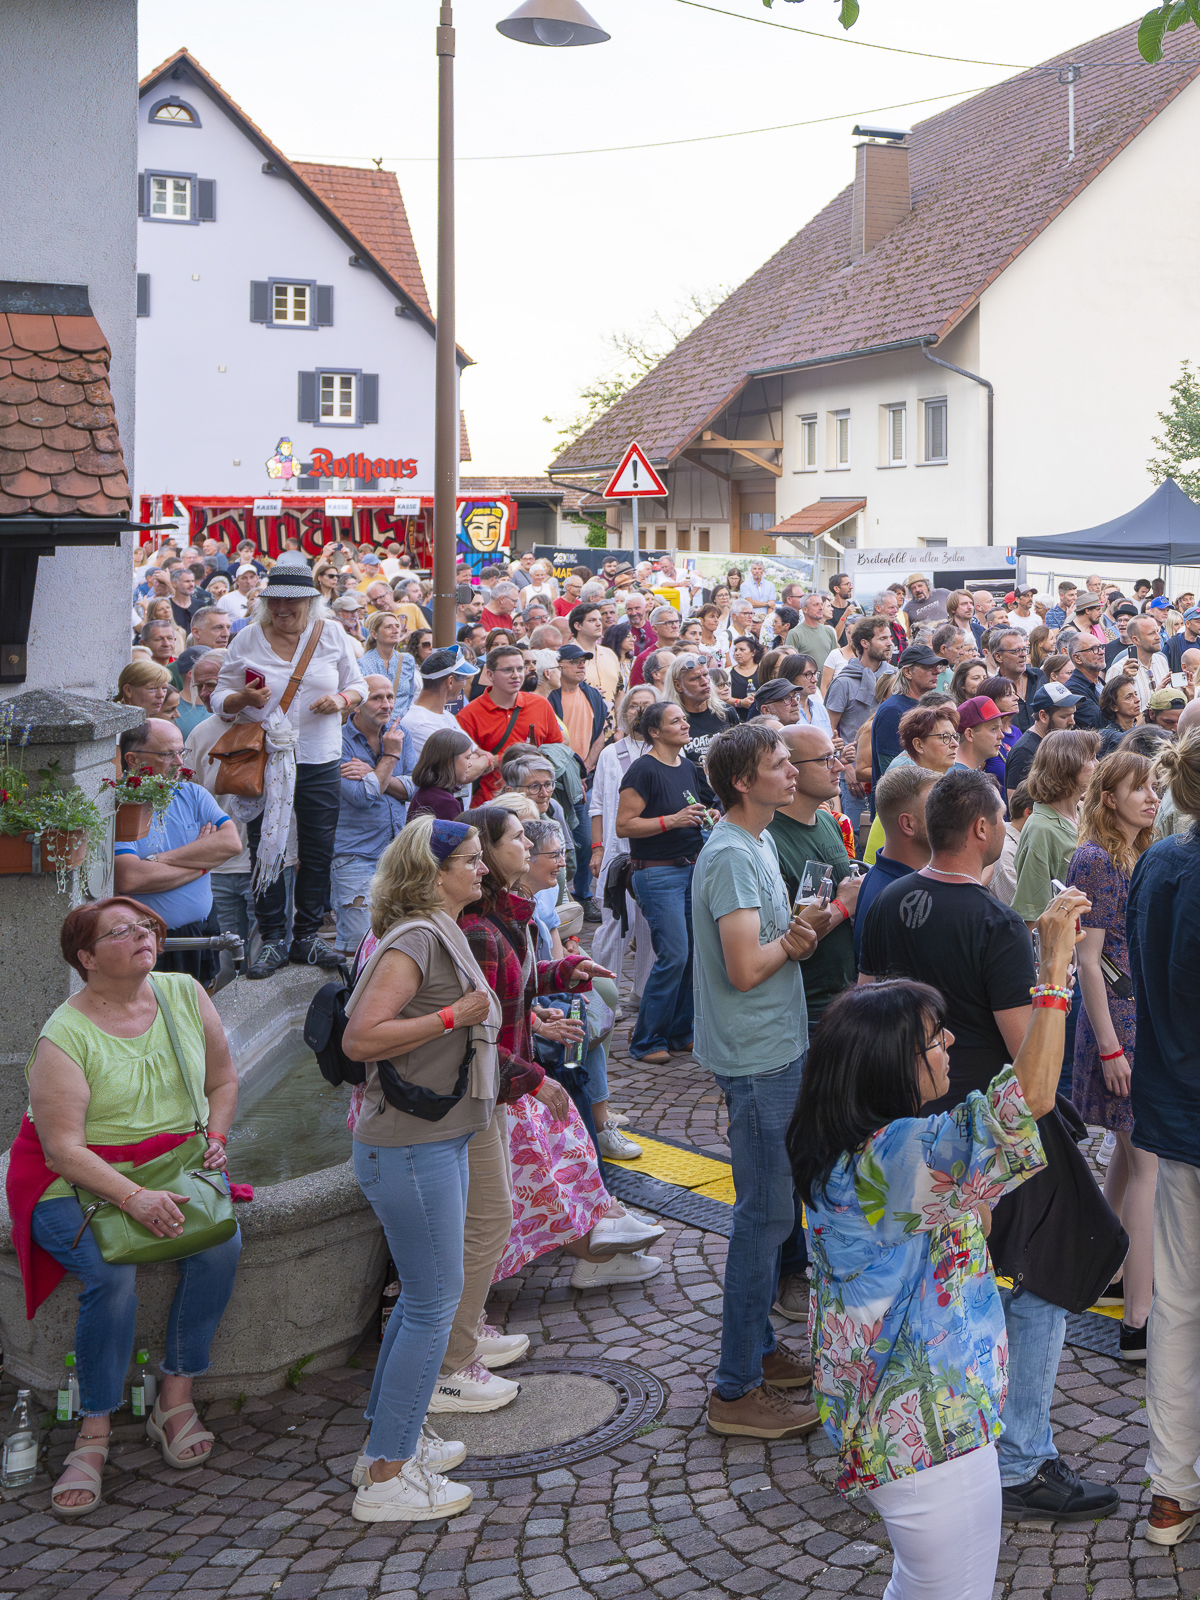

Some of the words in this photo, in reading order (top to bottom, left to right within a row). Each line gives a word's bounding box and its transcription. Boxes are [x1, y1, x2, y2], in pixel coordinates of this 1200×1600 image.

[307, 447, 418, 483] Rothaus
[854, 551, 907, 566] Breitenfeld
[438, 1386, 461, 1397] HOKA
